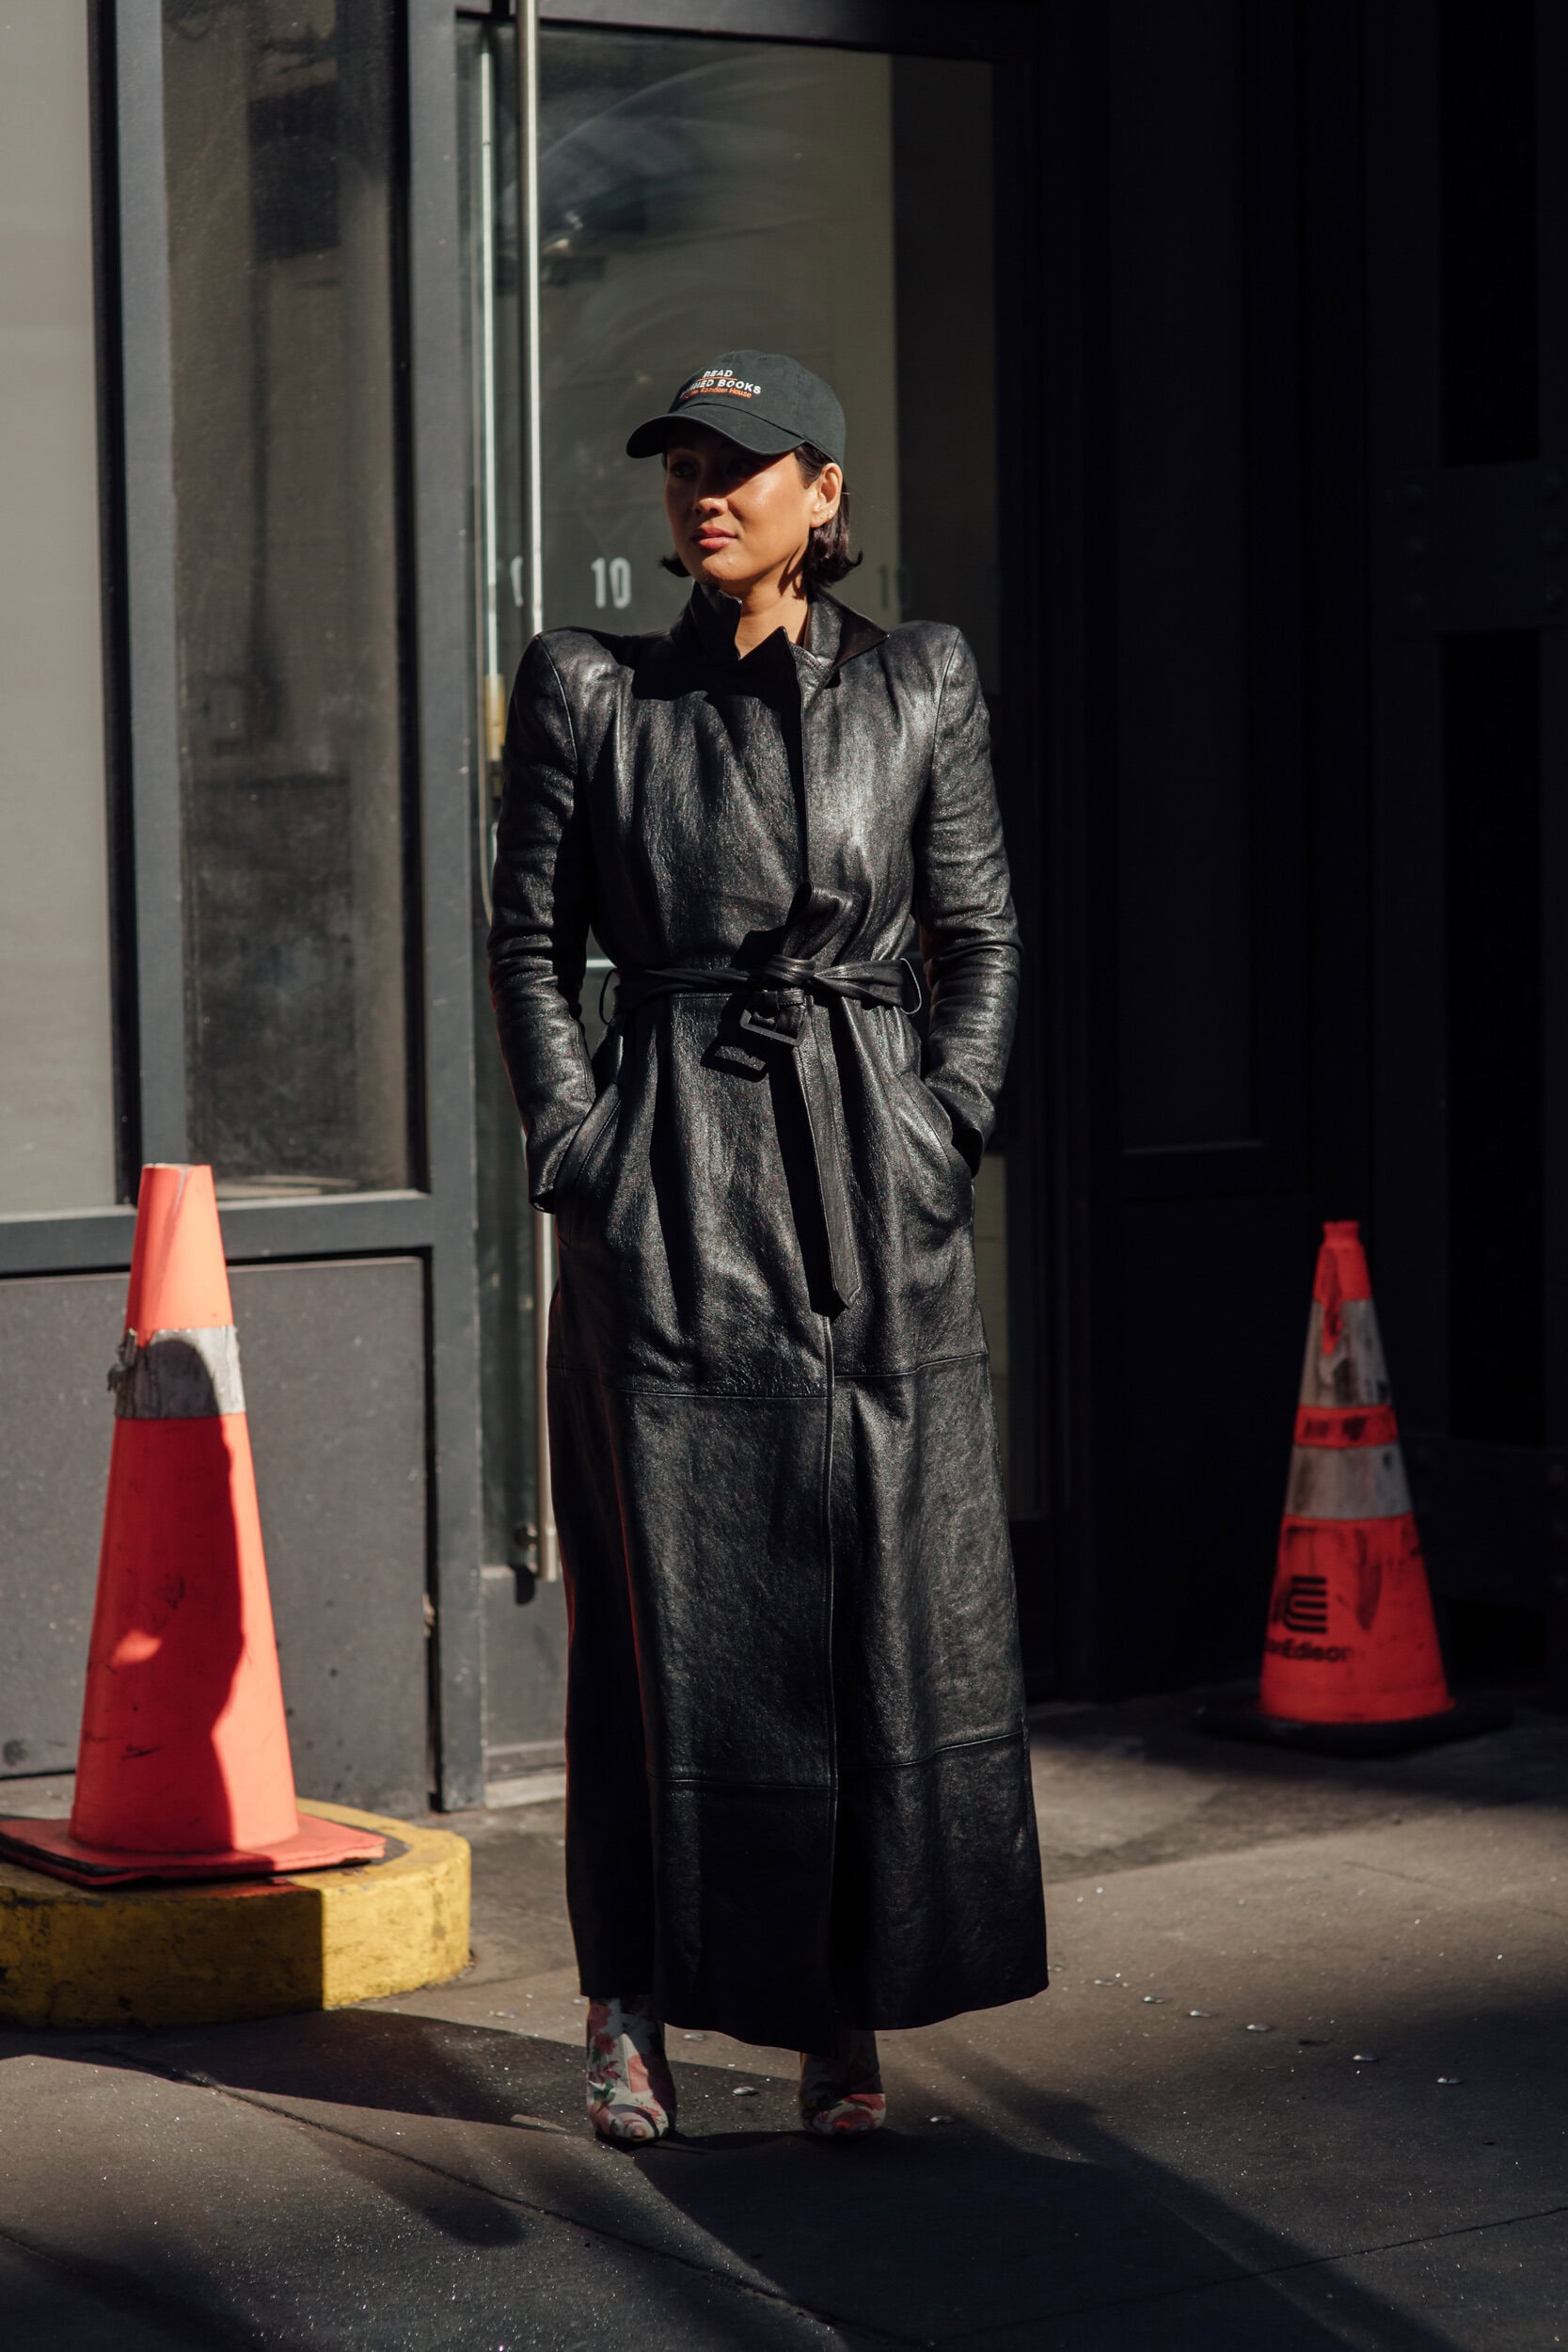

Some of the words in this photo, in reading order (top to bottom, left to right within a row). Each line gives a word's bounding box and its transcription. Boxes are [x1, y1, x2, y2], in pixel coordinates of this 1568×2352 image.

[703, 370, 734, 378] READ
[717, 379, 762, 394] BOOKS
[729, 388, 752, 399] House
[590, 557, 631, 609] 10
